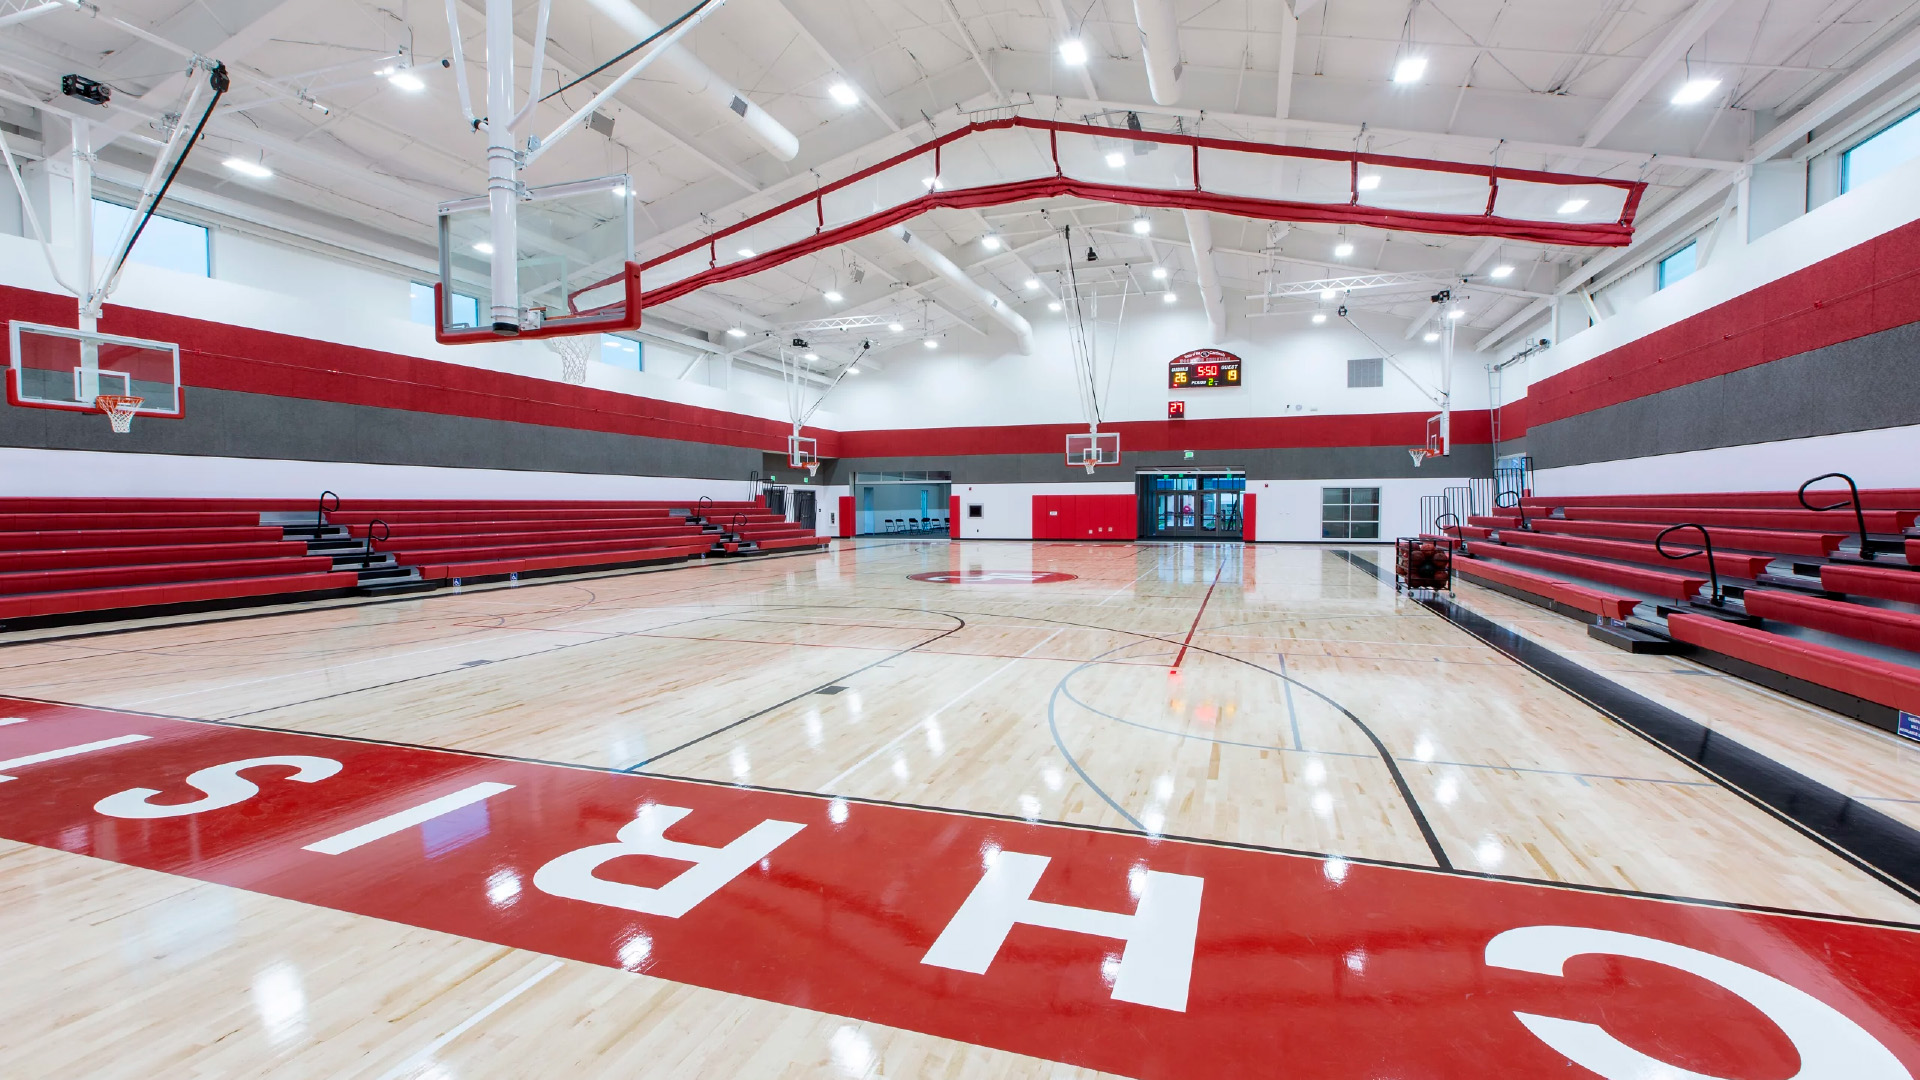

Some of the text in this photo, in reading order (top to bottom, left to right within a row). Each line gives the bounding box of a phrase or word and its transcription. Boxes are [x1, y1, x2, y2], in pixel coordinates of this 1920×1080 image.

[1198, 365, 1217, 376] 5:50
[1227, 370, 1237, 381] 19
[1174, 372, 1187, 383] 26
[1208, 378, 1213, 386] 2
[1170, 402, 1183, 413] 27
